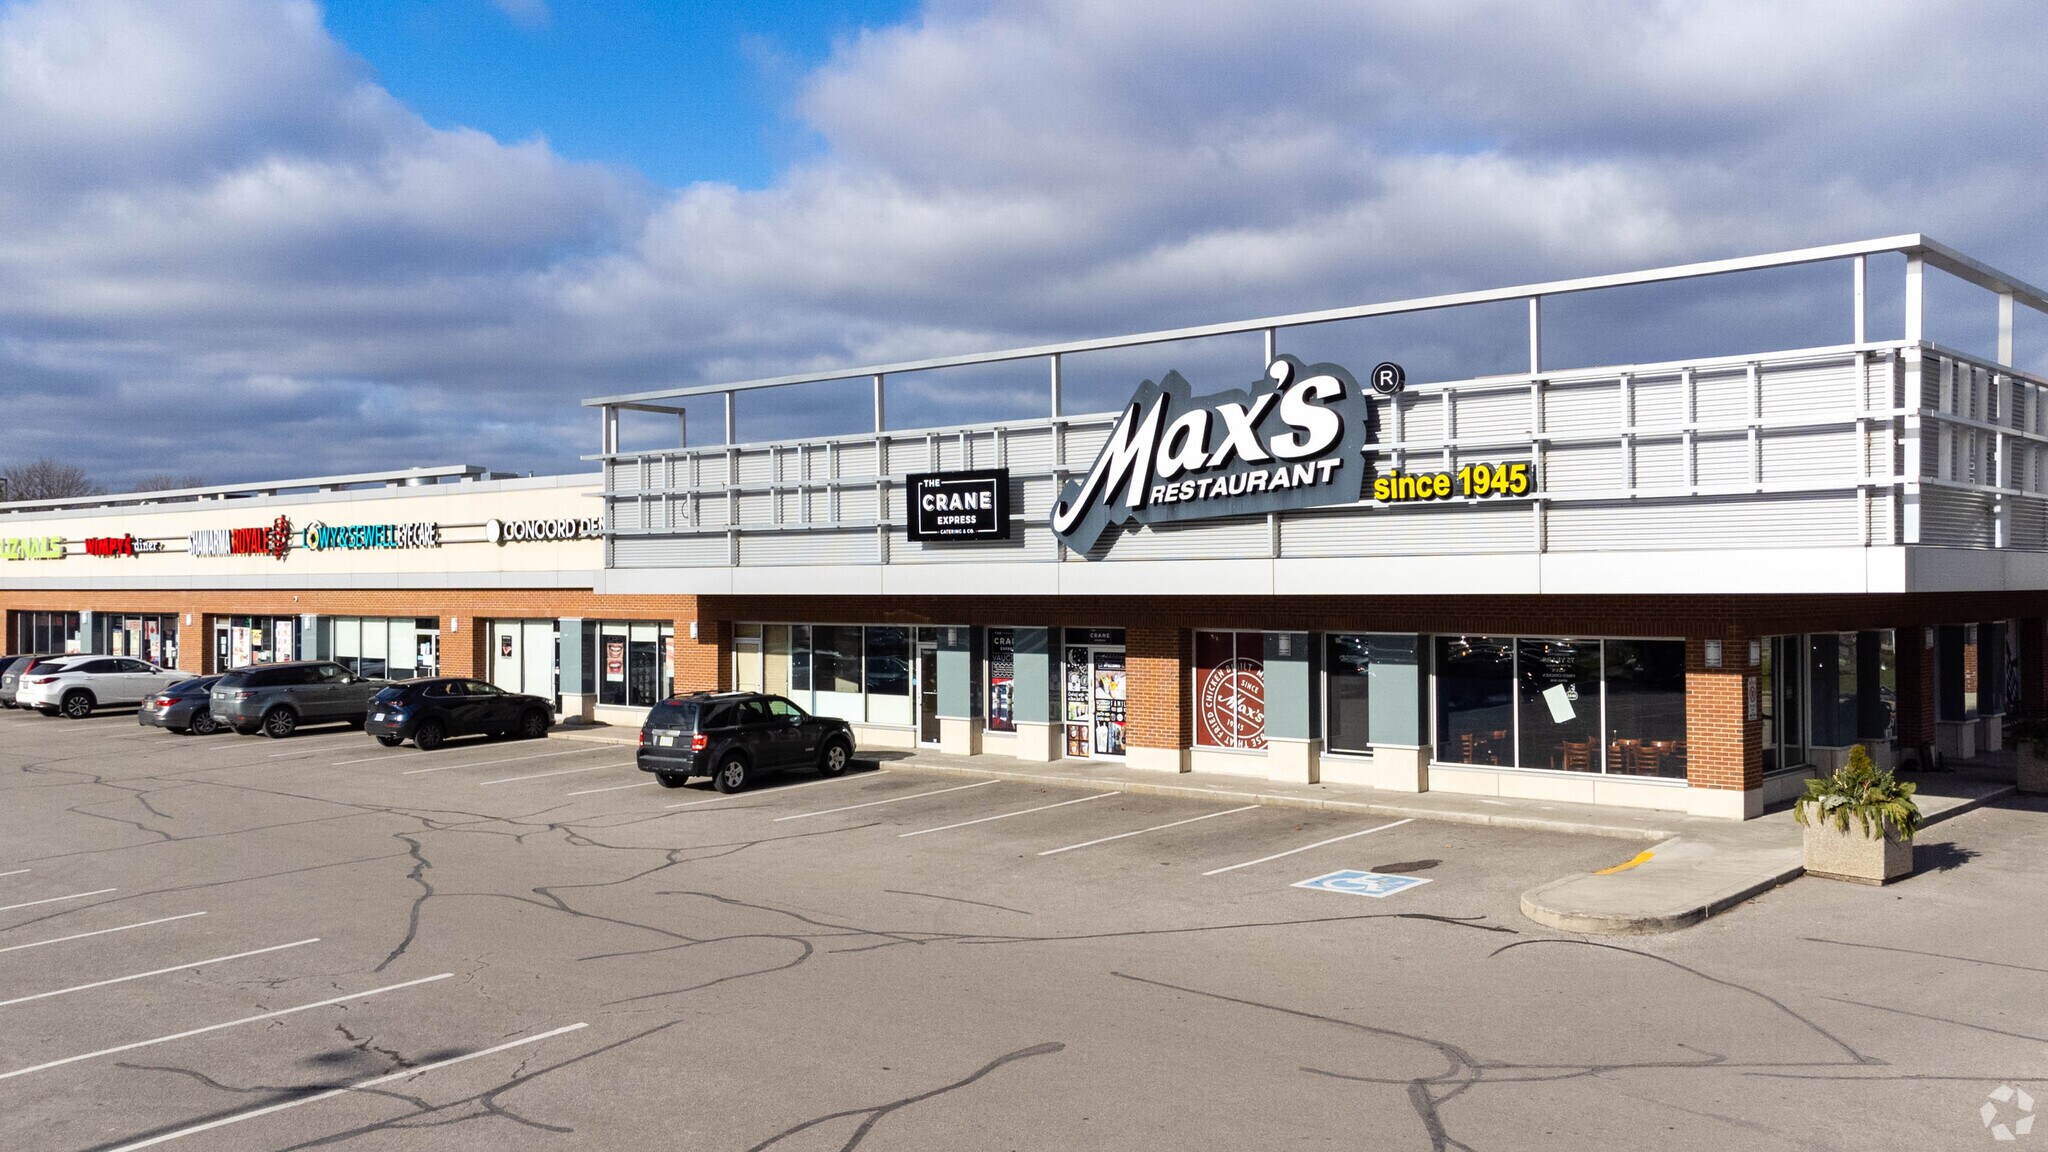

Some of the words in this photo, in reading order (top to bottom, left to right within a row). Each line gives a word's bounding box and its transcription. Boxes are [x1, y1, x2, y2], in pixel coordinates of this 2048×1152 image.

[1053, 359, 1347, 536] Max's
[923, 479, 941, 488] THE
[1149, 457, 1342, 505] RESTAURANT
[1373, 469, 1451, 502] since
[1457, 463, 1528, 496] 1945
[922, 492, 992, 511] CRANE
[504, 519, 576, 540] CONCORD
[937, 515, 977, 525] EXPRESS
[189, 529, 231, 555] SHAWARMA
[231, 527, 270, 554] ROYALE
[348, 525, 398, 547] SEWELL
[1205, 669, 1225, 707] CHICKEN
[1240, 679, 1259, 694] SINCE
[1207, 712, 1224, 738] FRIED
